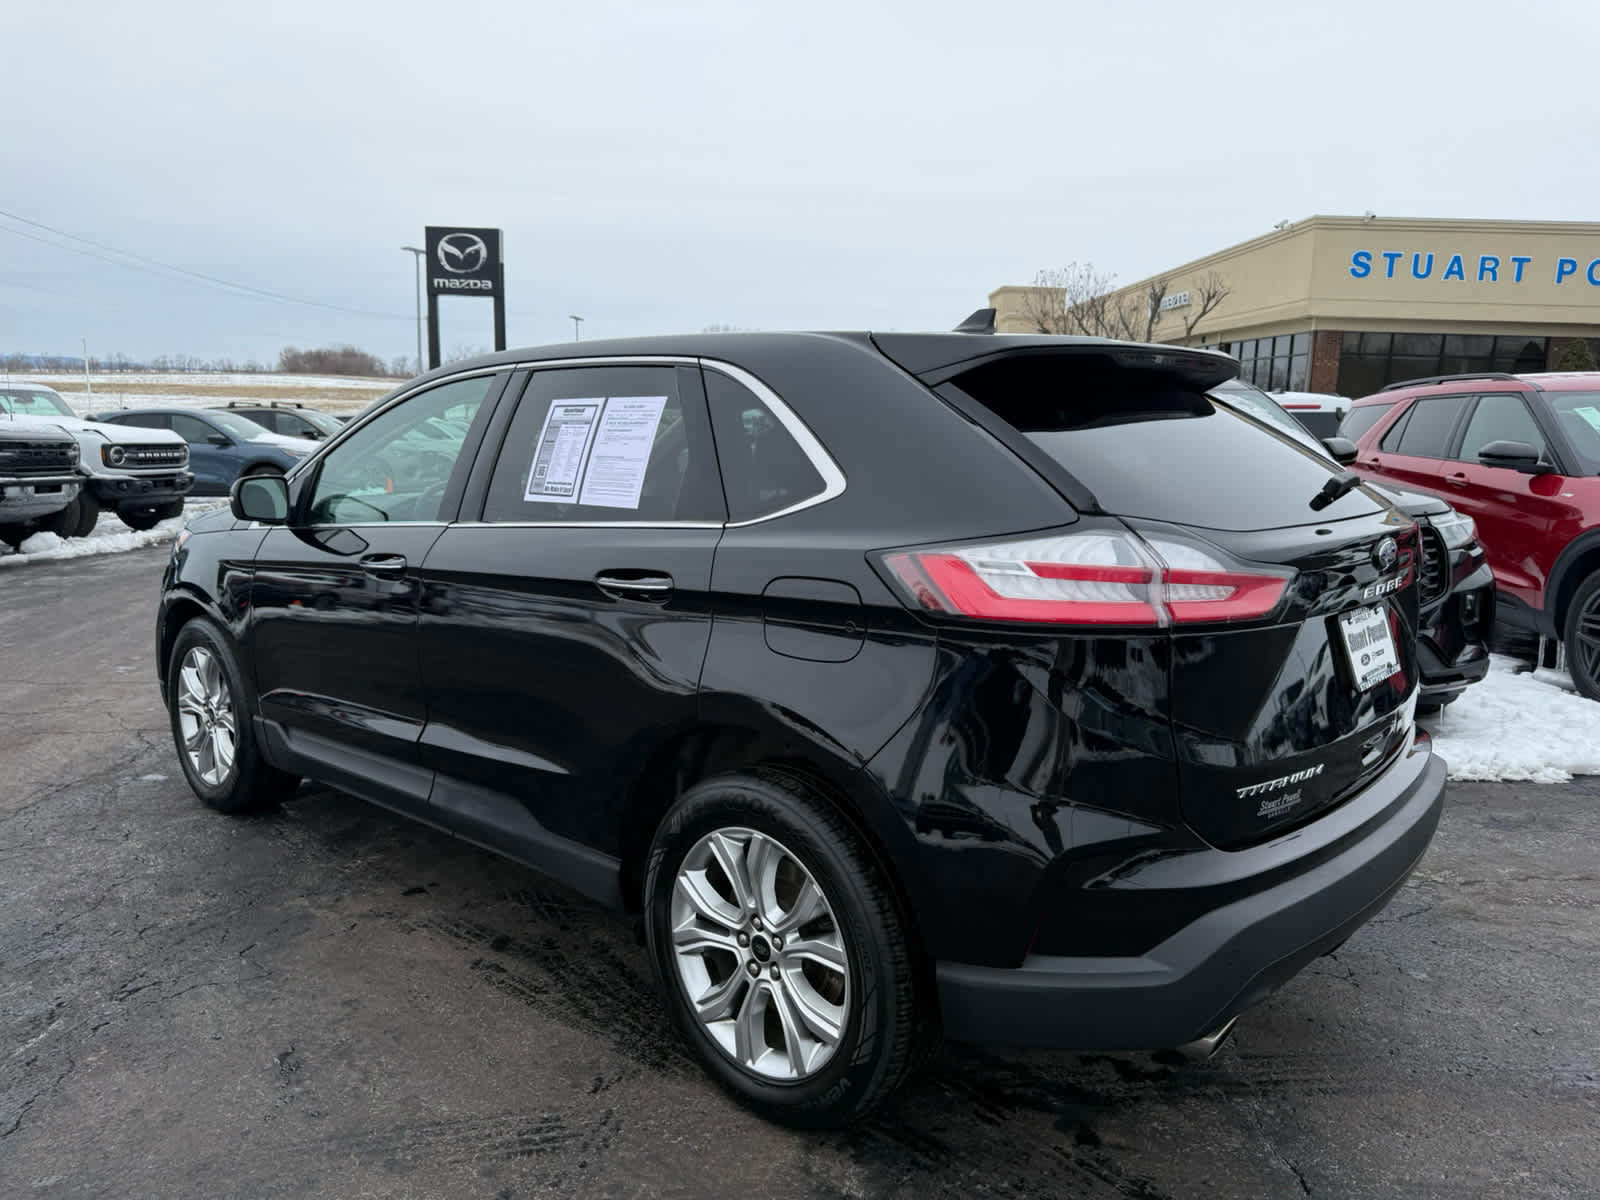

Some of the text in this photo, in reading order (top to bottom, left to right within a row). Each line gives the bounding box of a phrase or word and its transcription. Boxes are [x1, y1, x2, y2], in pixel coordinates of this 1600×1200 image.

[1349, 250, 1532, 283] STUART
[433, 278, 493, 290] mazda
[1363, 576, 1403, 600] EDGE
